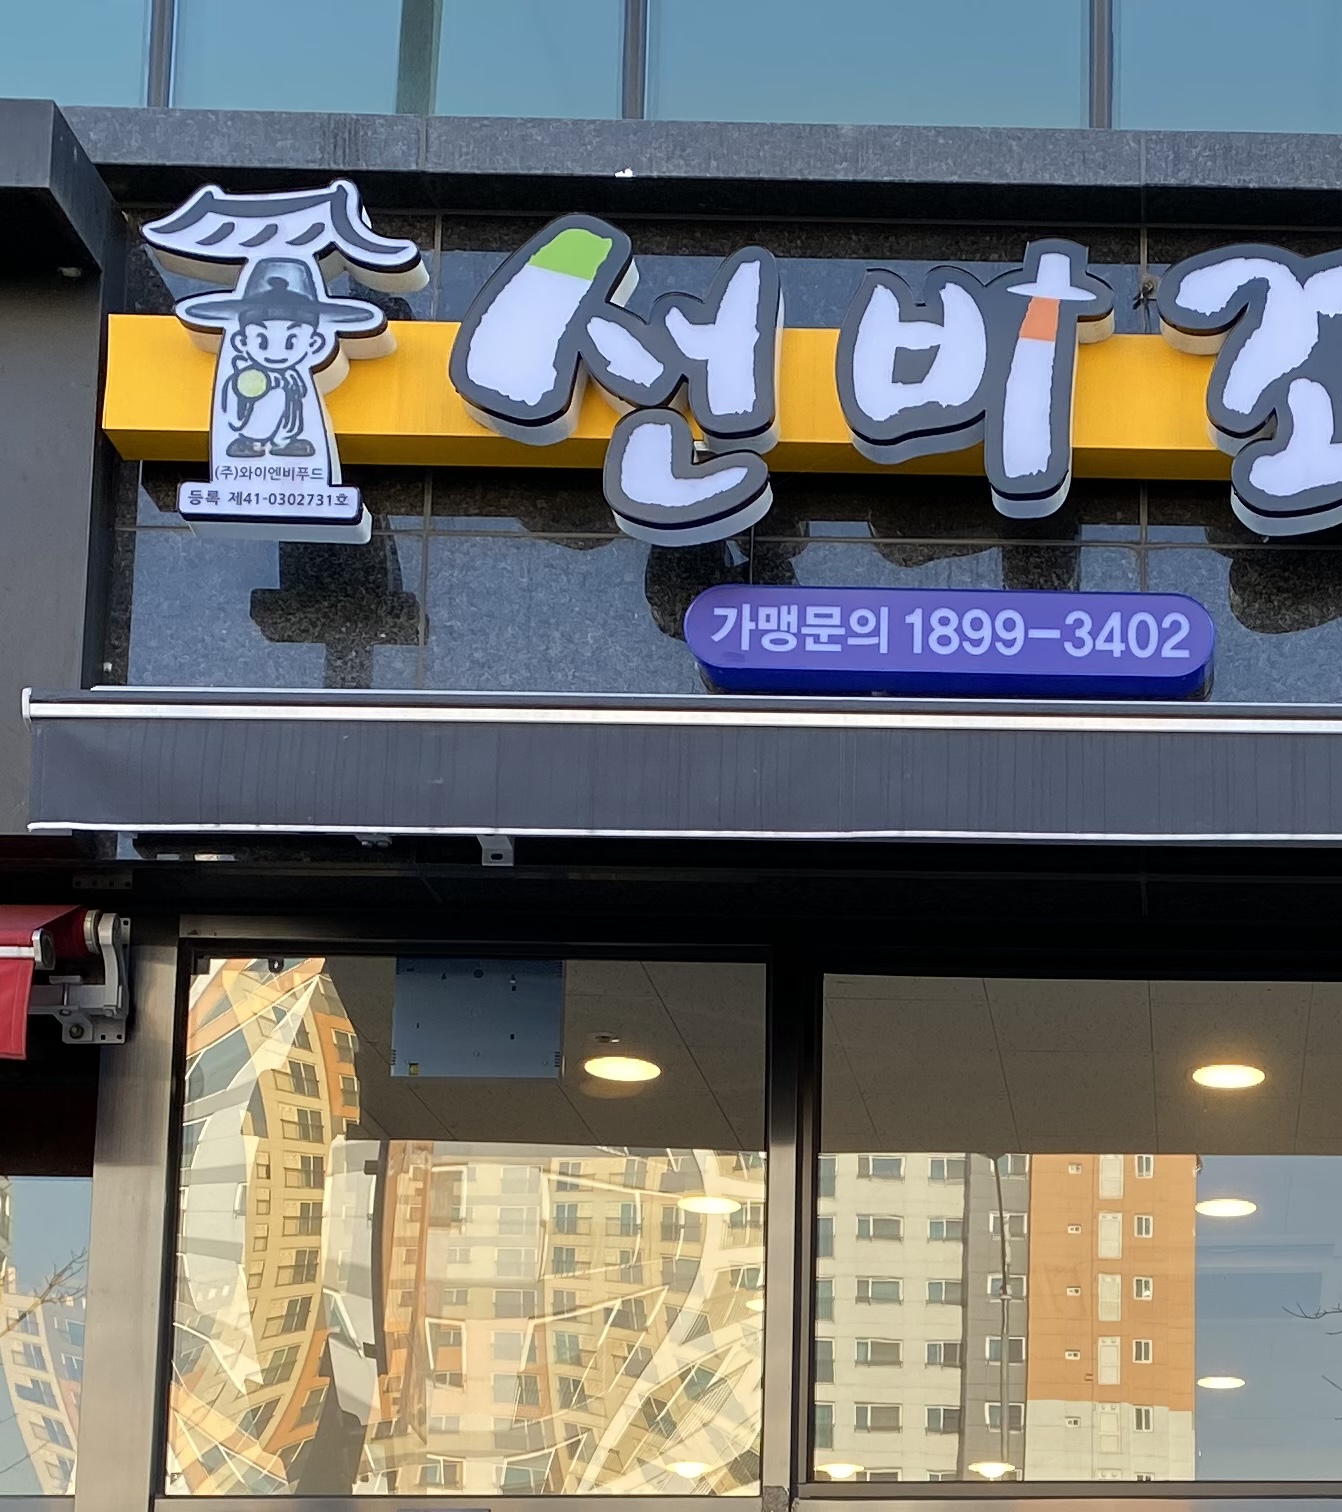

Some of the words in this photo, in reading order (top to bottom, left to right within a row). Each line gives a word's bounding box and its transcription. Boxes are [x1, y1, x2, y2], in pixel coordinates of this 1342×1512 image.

[214, 465, 325, 481] (주)와이엔비푸드
[187, 490, 221, 506] 등록
[227, 491, 350, 507] 제41-0302731호
[710, 604, 889, 654] 가맹문의
[904, 606, 1192, 659] 1899-3402
